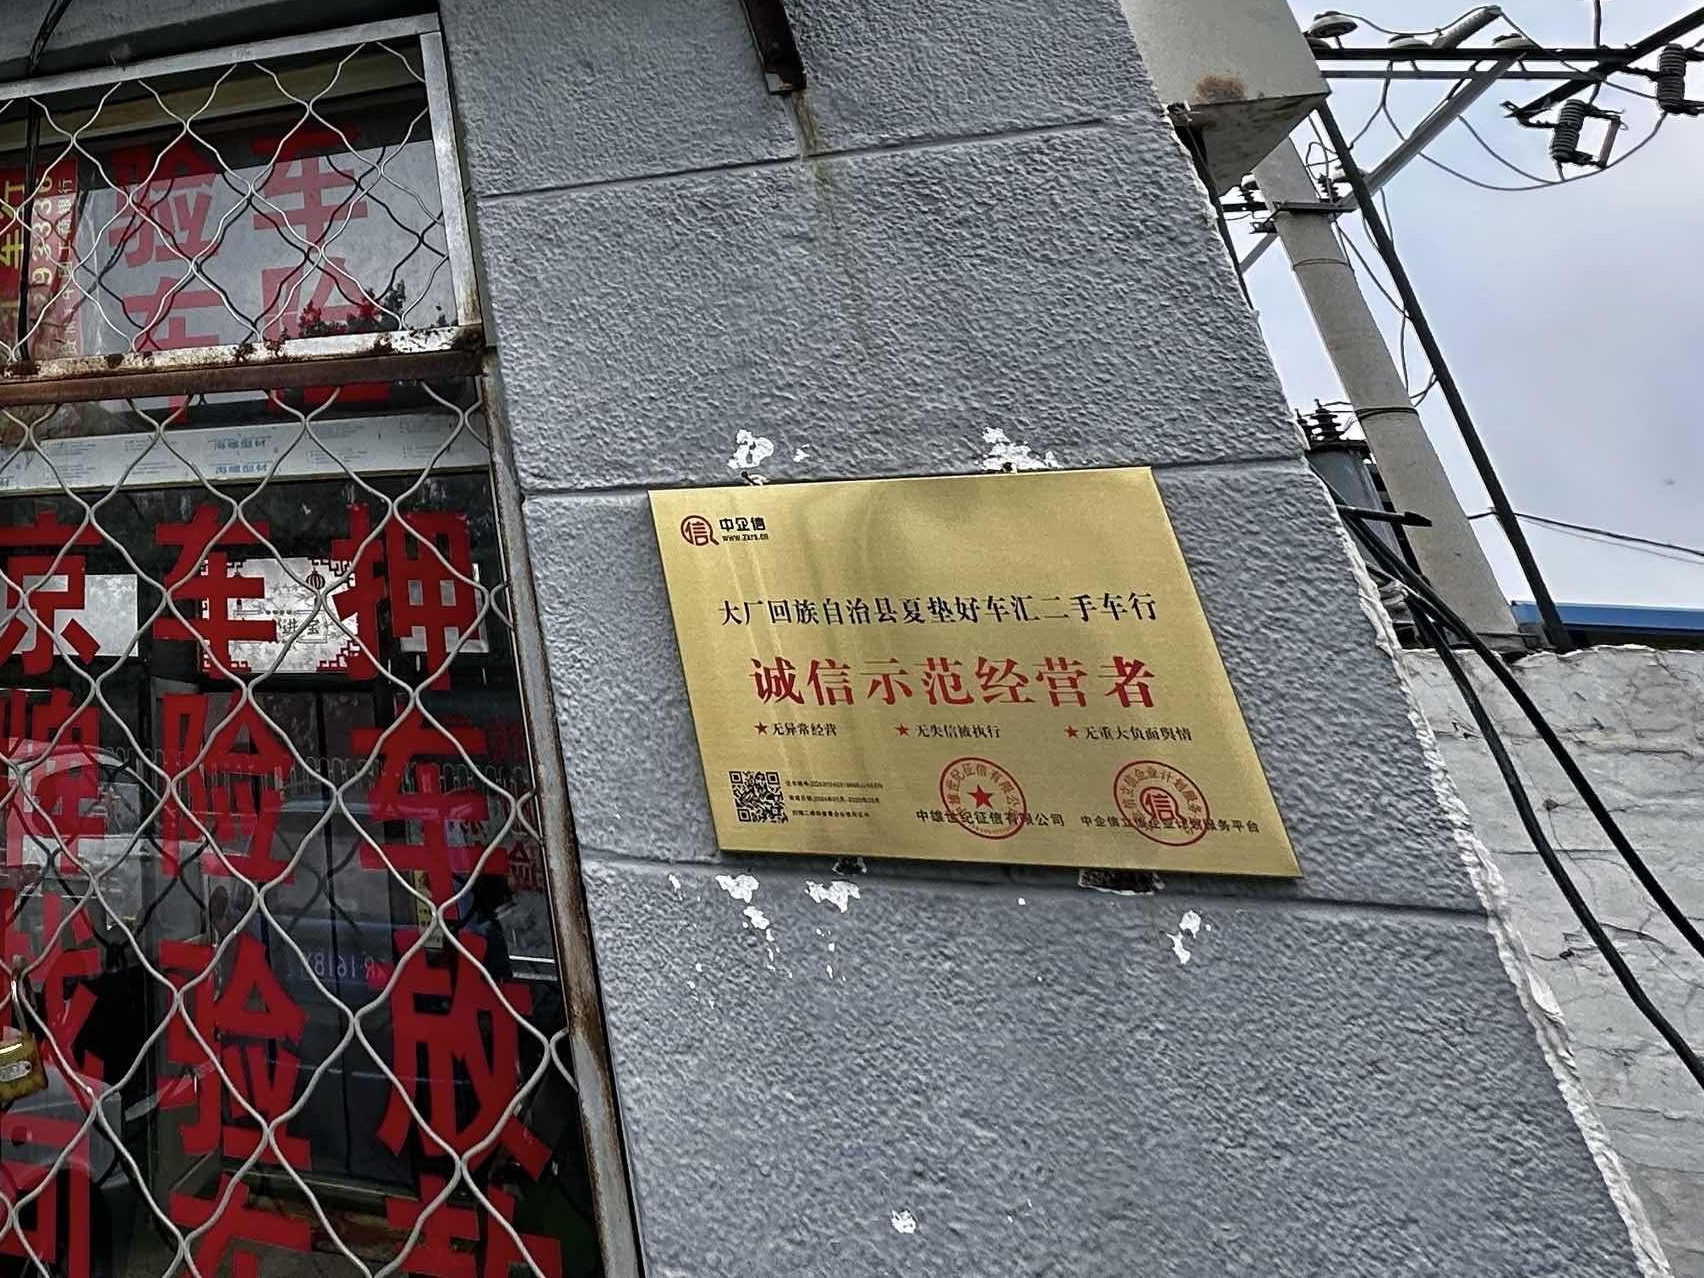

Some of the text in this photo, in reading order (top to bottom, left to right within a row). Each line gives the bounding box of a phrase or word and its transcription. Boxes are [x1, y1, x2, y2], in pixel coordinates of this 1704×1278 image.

[718, 517, 766, 532] 中企信
[718, 591, 1158, 627] 大厂回族自治县夏垫好车汇二手车行
[749, 655, 1156, 709] 诚信示范经营者
[771, 722, 838, 737] 无异常经营
[915, 723, 1001, 739] 无失信被执行
[1084, 725, 1193, 741] 无重大负面舆情
